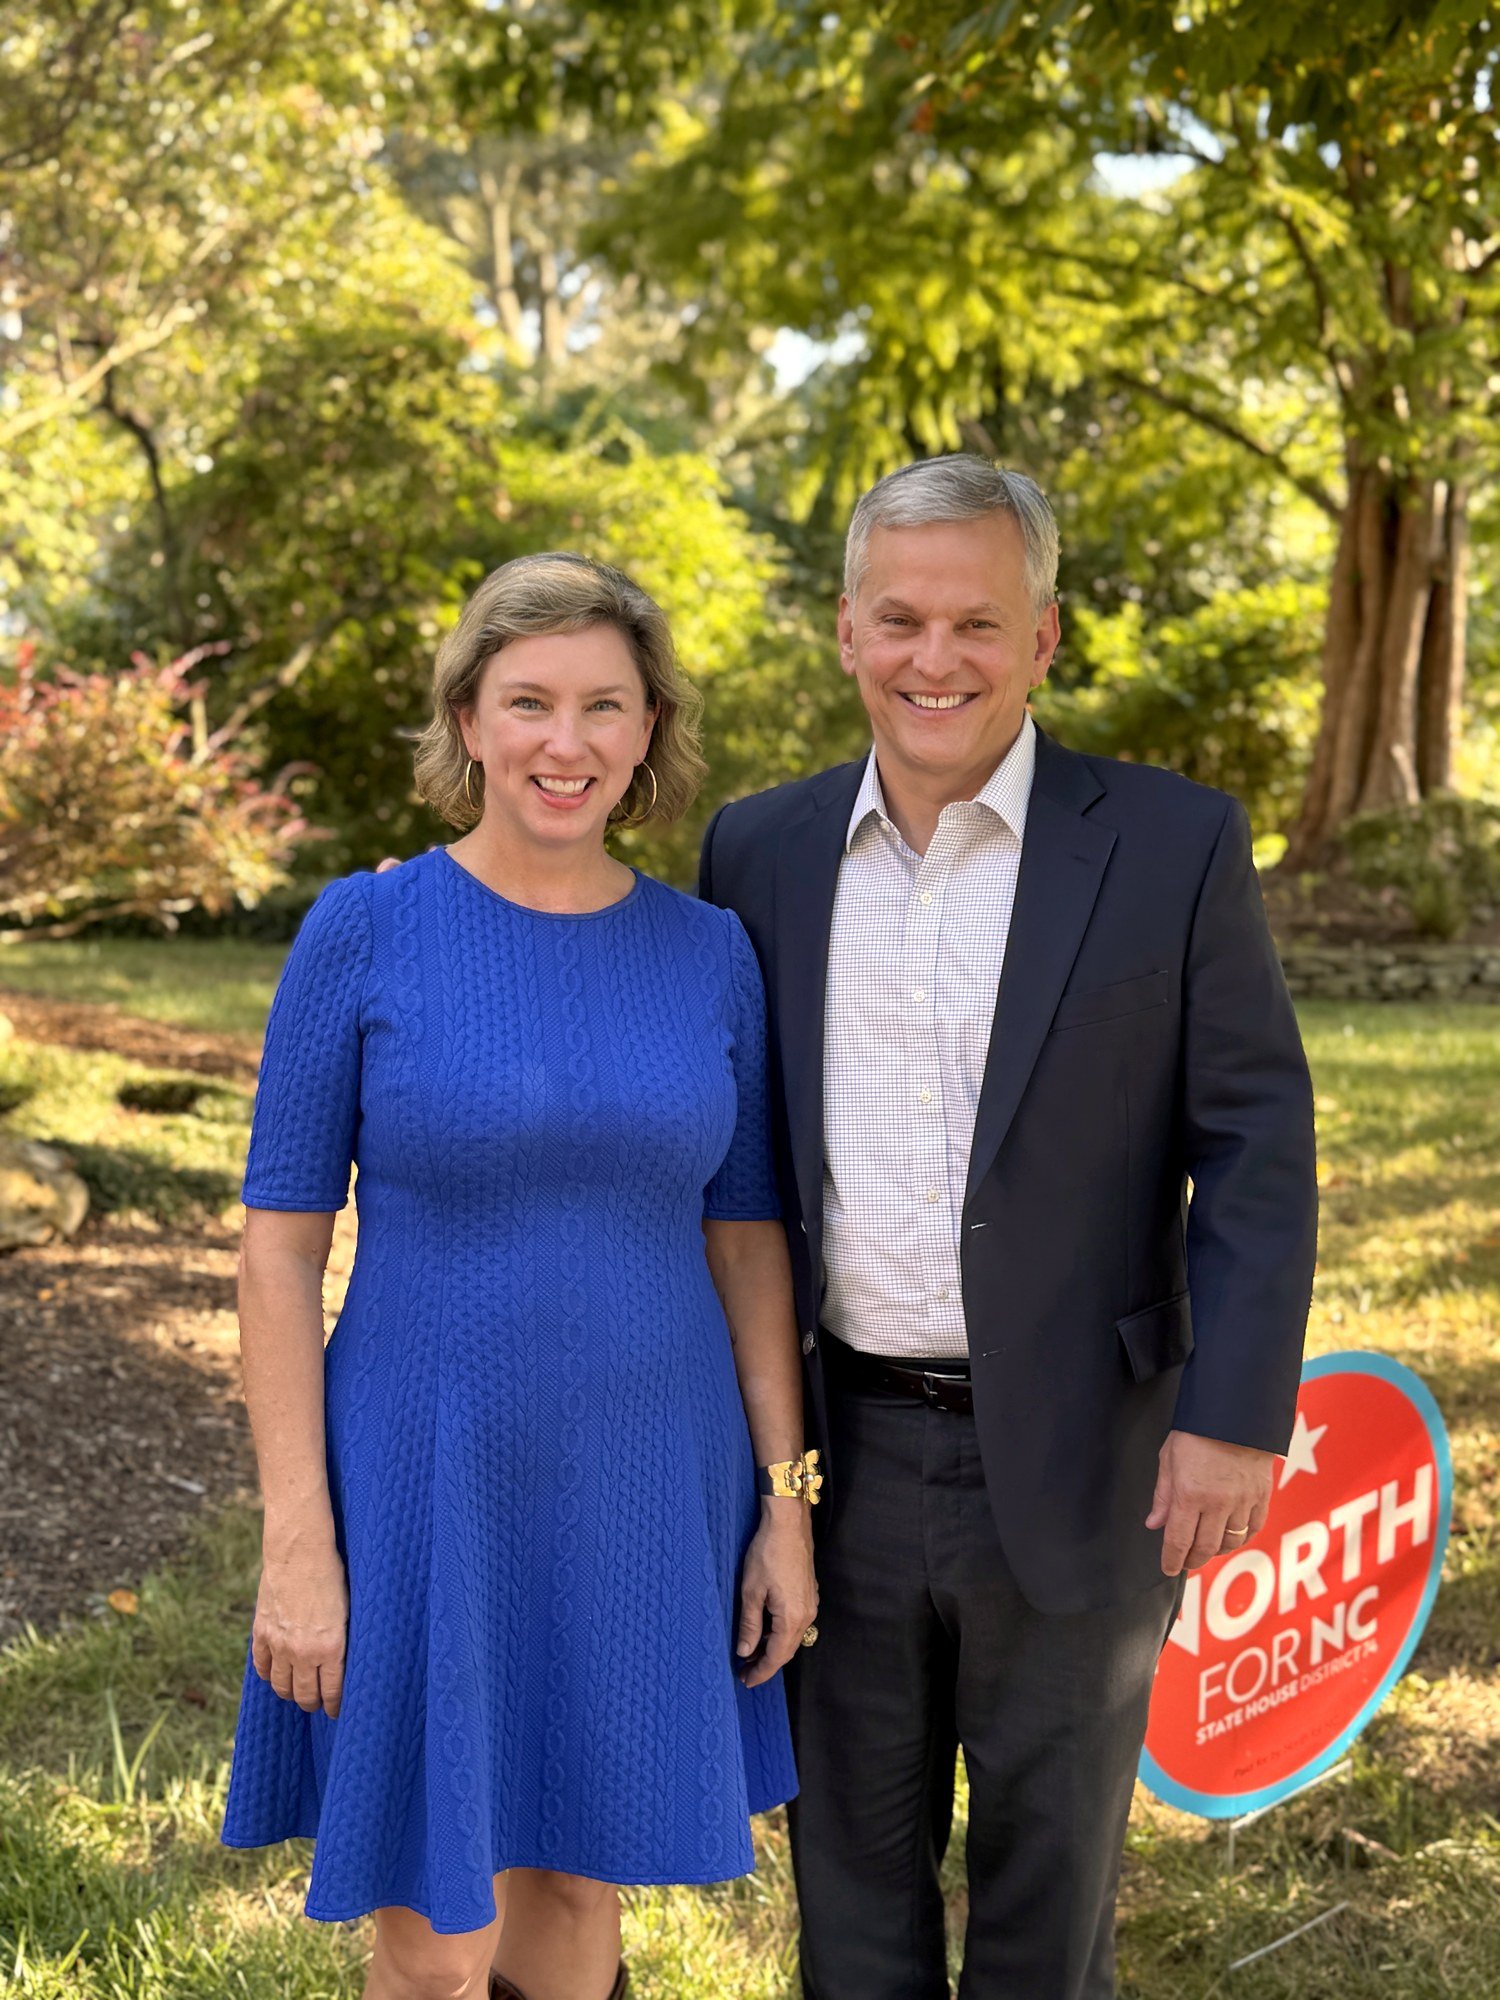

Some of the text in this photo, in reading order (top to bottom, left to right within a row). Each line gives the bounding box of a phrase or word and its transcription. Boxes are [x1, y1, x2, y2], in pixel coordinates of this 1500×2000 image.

[1196, 1708, 1243, 1745] STATE
[1245, 1679, 1299, 1721] HOUSE
[1300, 1645, 1361, 1692] DISTRICT
[1199, 1586, 1378, 1723] FOR NC
